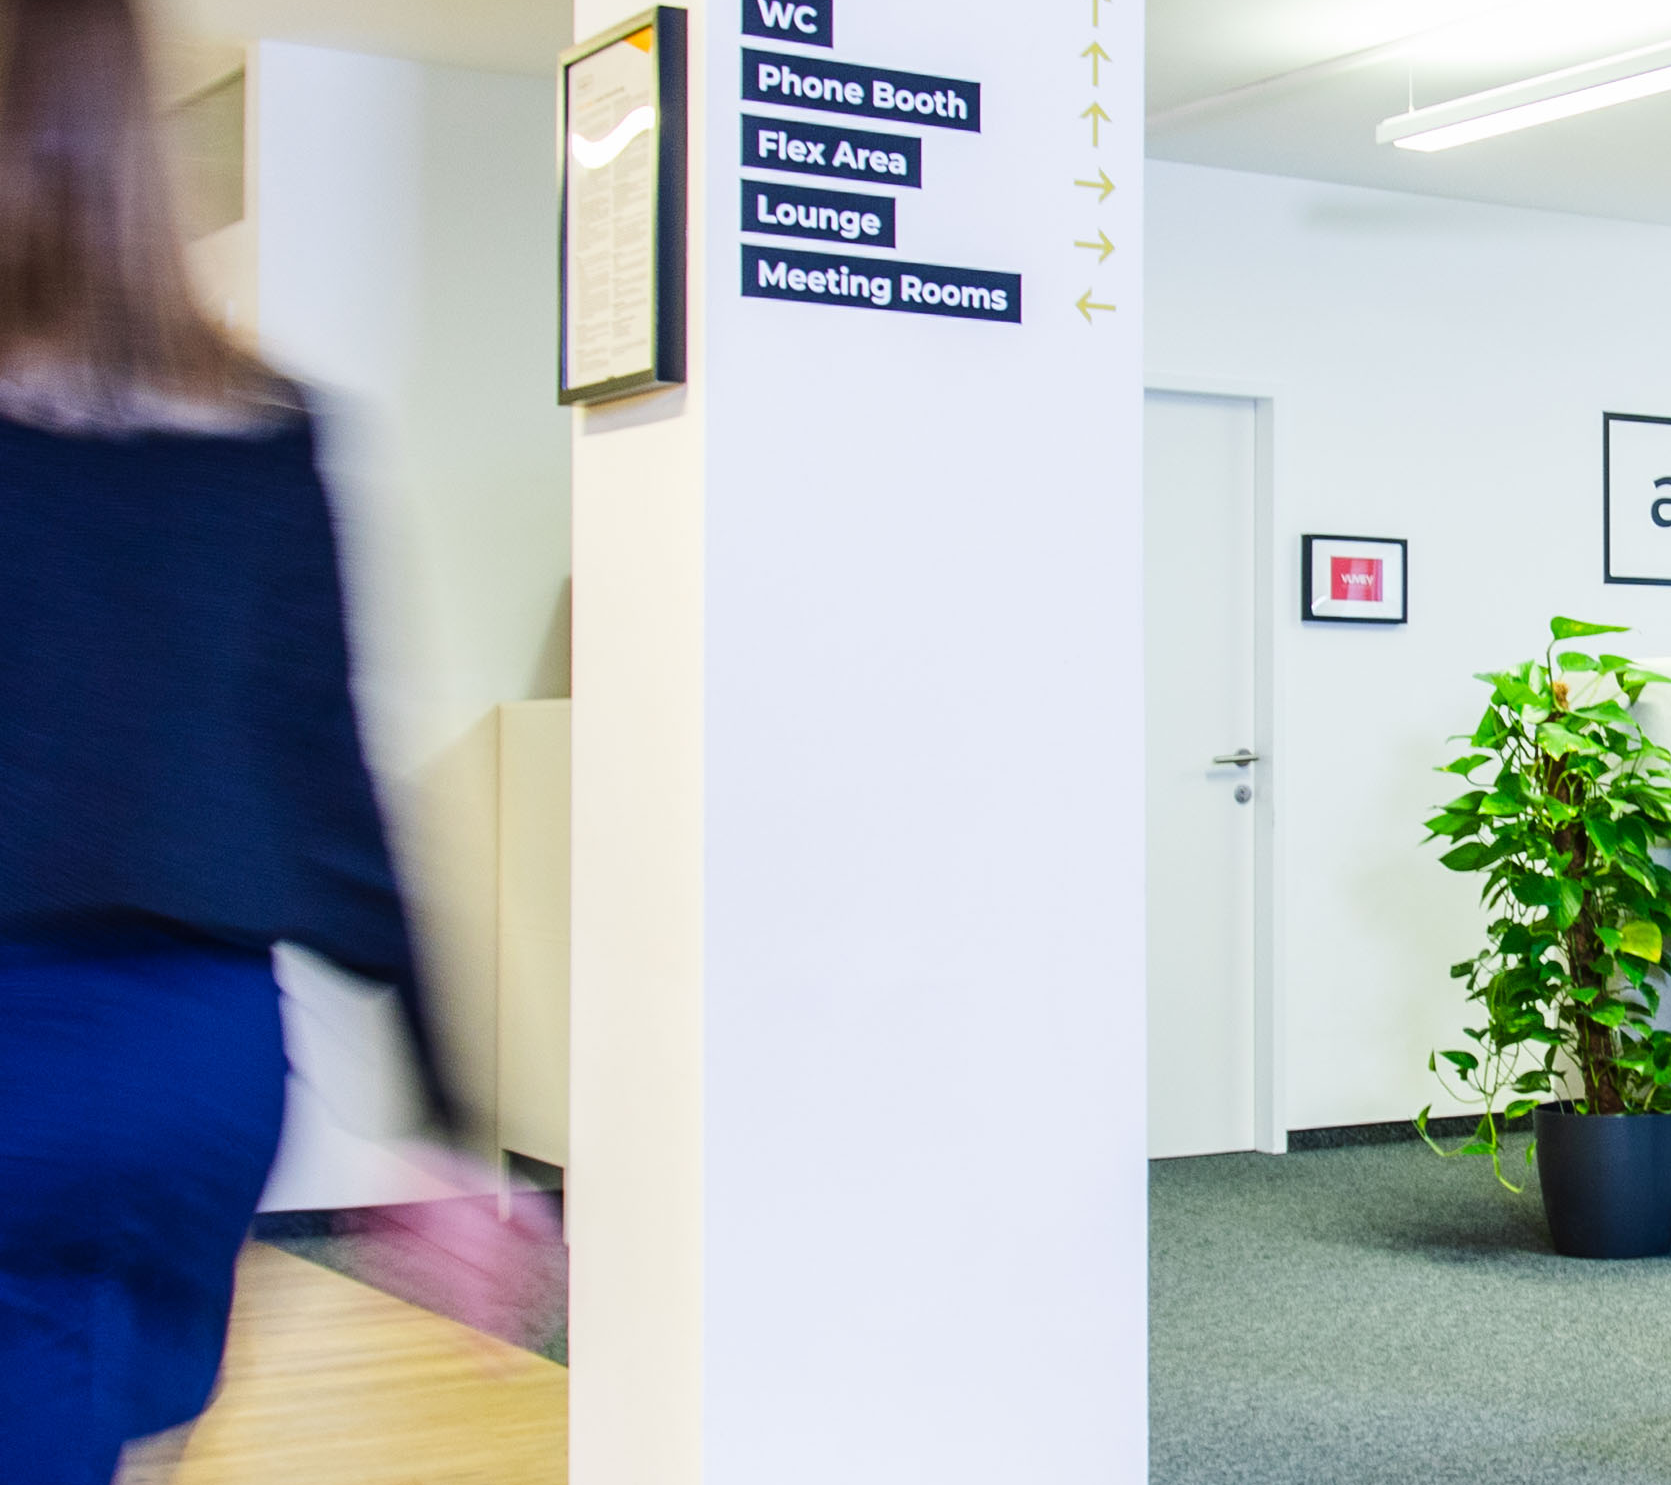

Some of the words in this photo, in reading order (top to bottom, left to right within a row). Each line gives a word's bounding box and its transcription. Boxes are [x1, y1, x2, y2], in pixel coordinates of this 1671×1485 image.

[758, 63, 865, 105] Phone
[872, 80, 968, 120] Booth
[758, 129, 826, 166] Flex
[831, 140, 907, 176] Area
[757, 194, 882, 240] Lounge
[758, 259, 892, 307] Meeting
[900, 274, 1008, 311] Rooms
